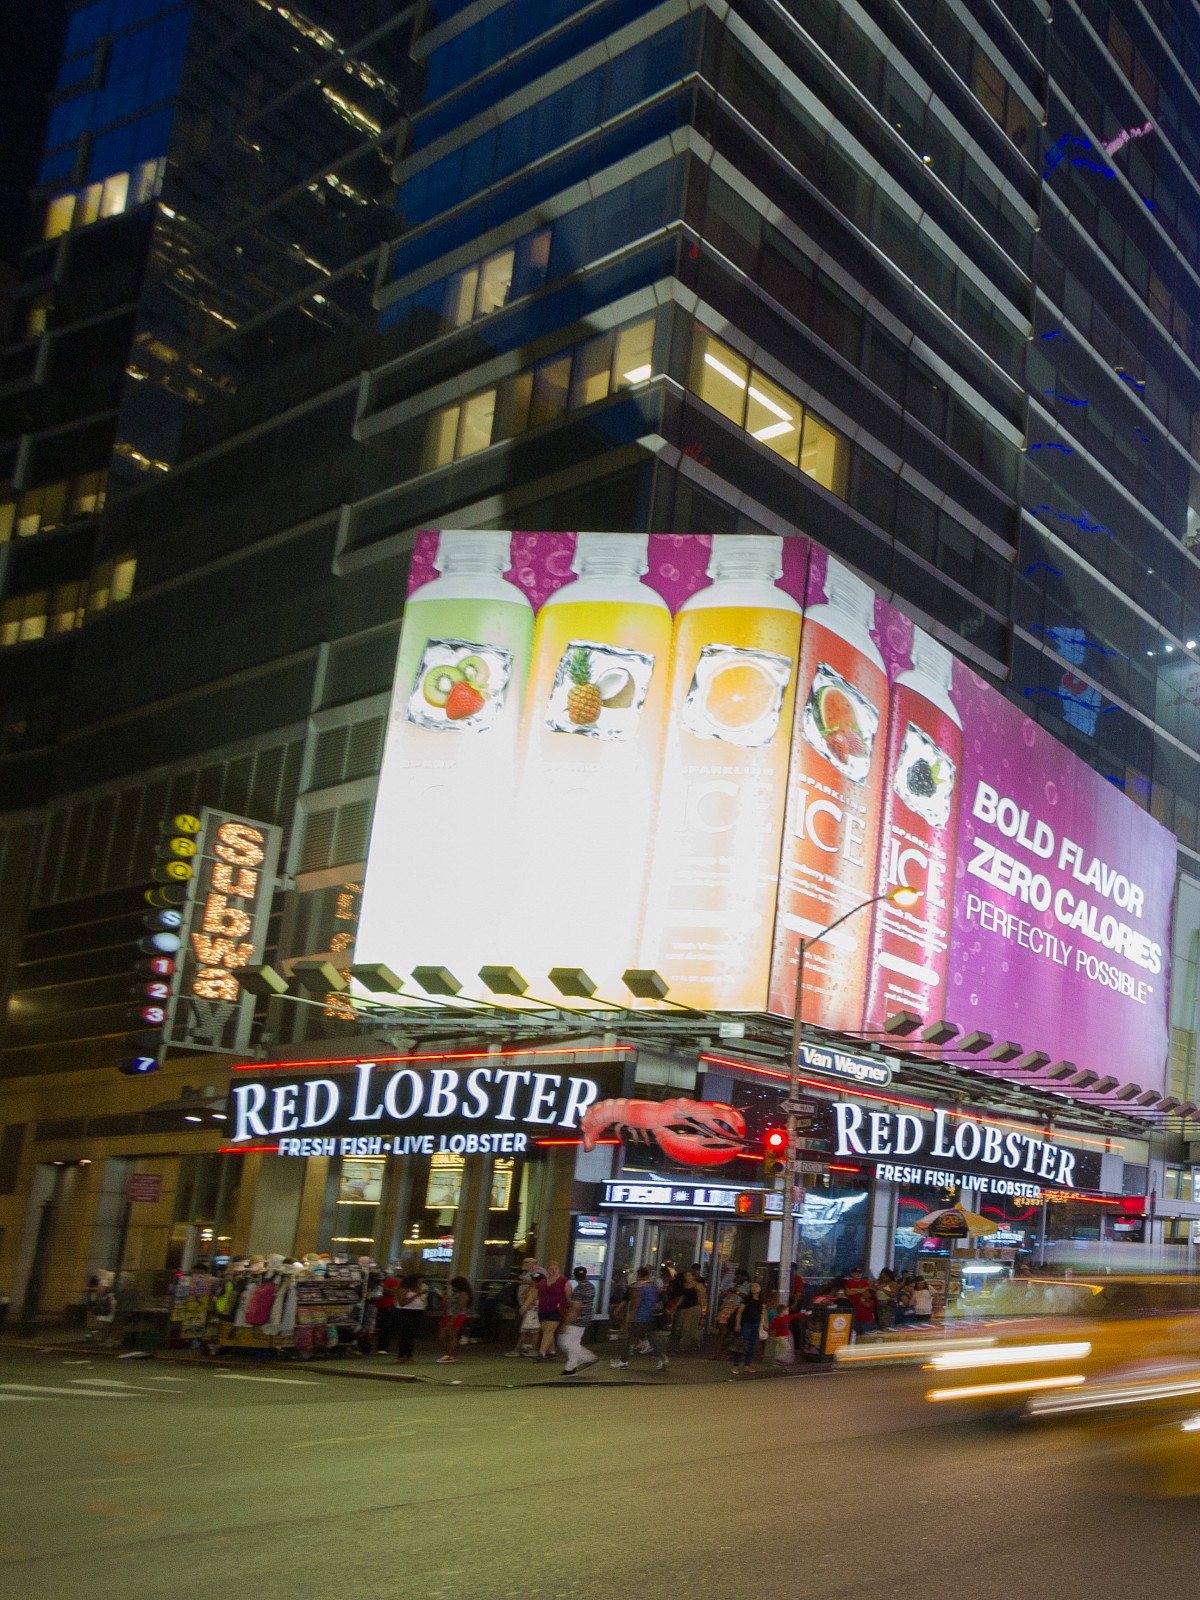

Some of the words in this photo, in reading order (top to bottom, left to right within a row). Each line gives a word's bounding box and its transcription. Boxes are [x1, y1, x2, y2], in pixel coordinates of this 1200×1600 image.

[793, 788, 866, 868] ICE
[972, 780, 1055, 859] BOLD
[1057, 836, 1145, 919] FLAVOR
[887, 838, 947, 909] ICE
[967, 836, 1052, 912] ZERO
[1054, 888, 1162, 975] CALORIES
[966, 893, 1073, 967] PERFECTLY
[146, 1007, 164, 1022] 3
[151, 983, 168, 998] 2
[137, 1057, 154, 1071] 7
[802, 1049, 834, 1070] Van
[834, 1055, 887, 1083] Wagner
[231, 1078, 340, 1143] RED
[348, 1062, 599, 1129] LOBSTER
[278, 1137, 335, 1157] FRESH
[340, 1136, 382, 1155] FISH
[392, 1134, 434, 1155] LIVE
[439, 1132, 527, 1154] LOBSTER
[832, 1102, 924, 1157] RED
[929, 1108, 1076, 1188] LOBSTER
[875, 1163, 922, 1185] FRESH
[924, 1165, 955, 1187] FISH
[962, 1174, 989, 1194] LIVE
[990, 1179, 1042, 1199] LOBSTER
